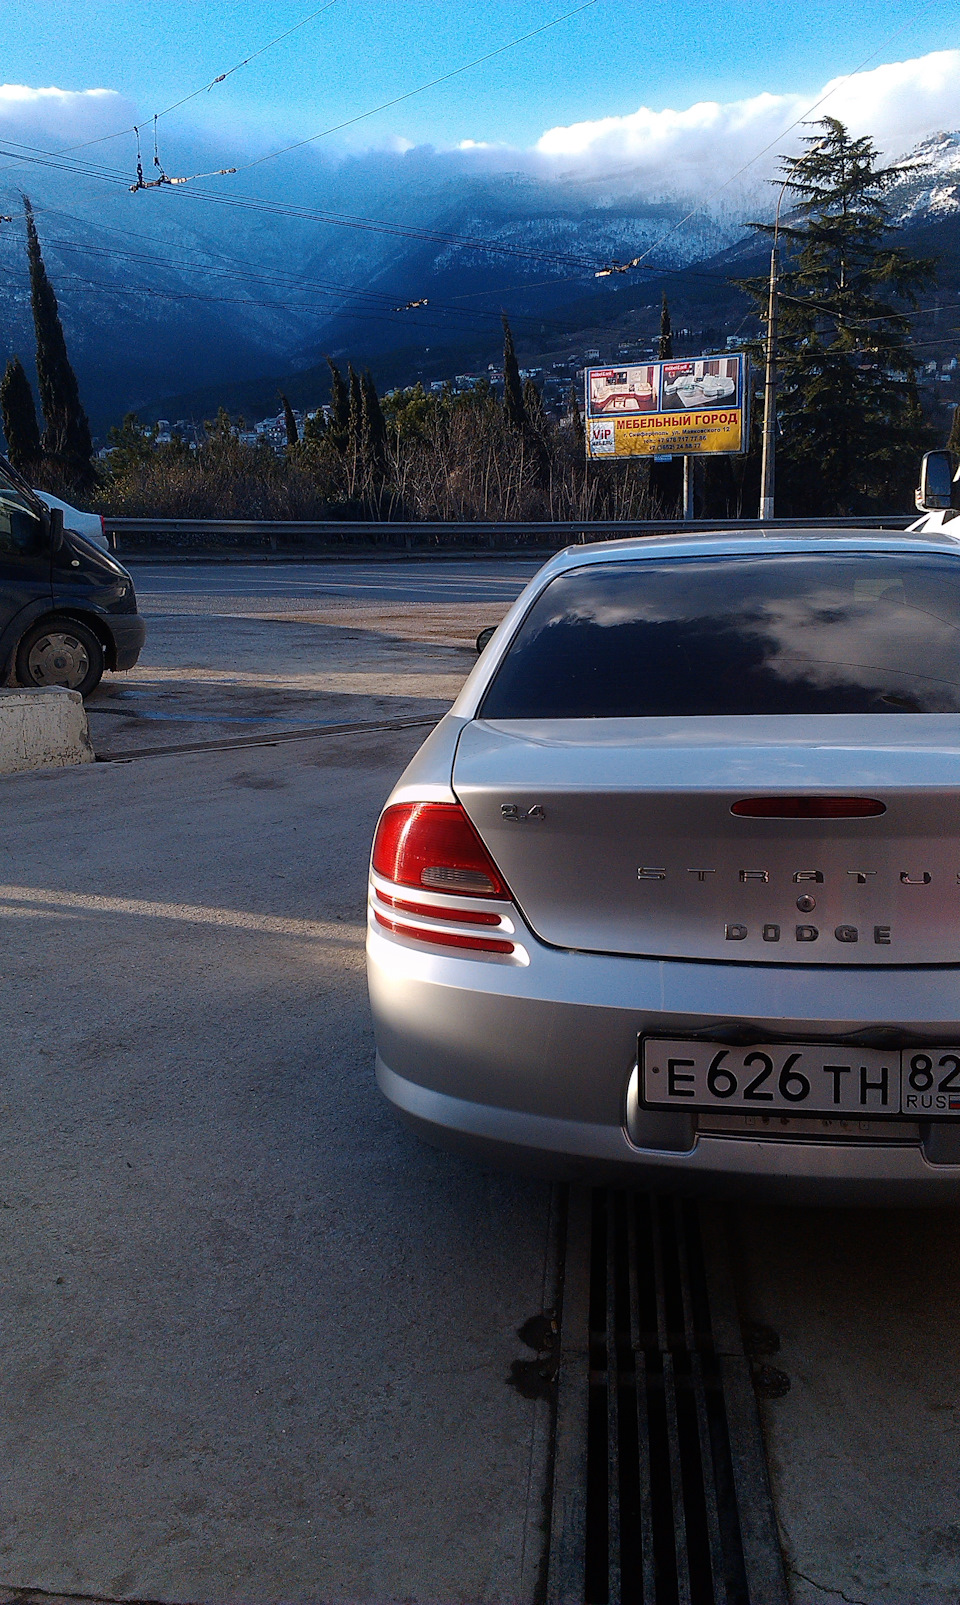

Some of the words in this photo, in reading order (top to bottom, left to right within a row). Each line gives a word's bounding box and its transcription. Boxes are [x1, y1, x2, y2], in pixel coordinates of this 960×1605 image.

[616, 414, 691, 430] МЕБЕЛЬНЫЙ
[695, 413, 738, 425] ГОРОД
[500, 803, 547, 822] 2.4
[636, 867, 960, 885] STRATU
[724, 922, 893, 945] DODGE
[909, 1053, 960, 1092] 82
[906, 1094, 947, 1109] RUS
